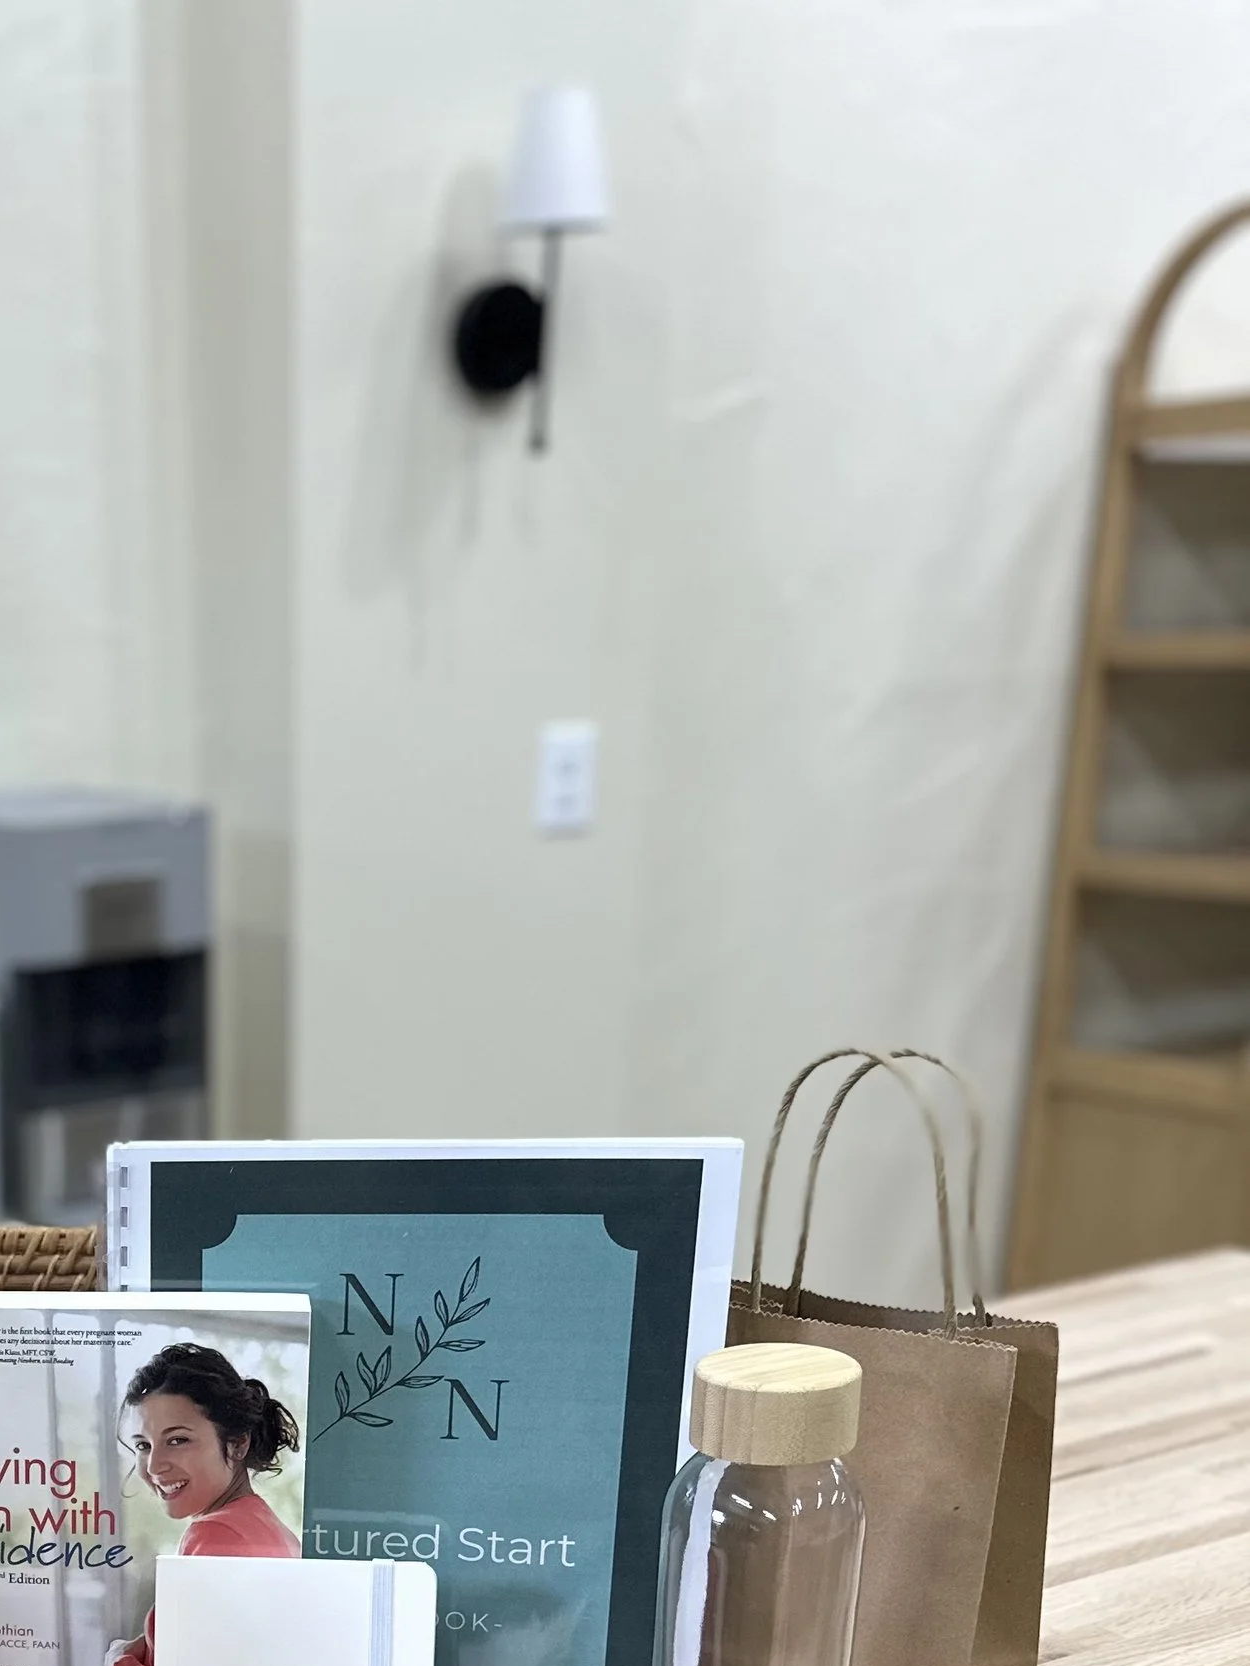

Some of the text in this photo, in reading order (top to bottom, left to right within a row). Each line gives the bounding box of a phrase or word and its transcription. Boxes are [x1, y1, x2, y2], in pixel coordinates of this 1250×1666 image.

[336, 1273, 404, 1336] N
[8, 1326, 19, 1335] the
[20, 1327, 33, 1335] first
[34, 1327, 51, 1335] book
[67, 1330, 84, 1338] every
[86, 1329, 115, 1338] pregnant
[51, 1337, 70, 1345] about
[83, 1339, 116, 1348] maternity
[440, 1379, 510, 1441] N
[29, 1492, 115, 1535] with
[303, 1524, 576, 1567] tured Start
[8, 1573, 50, 1585] Edition
[32, 1641, 60, 1649] FAAN
